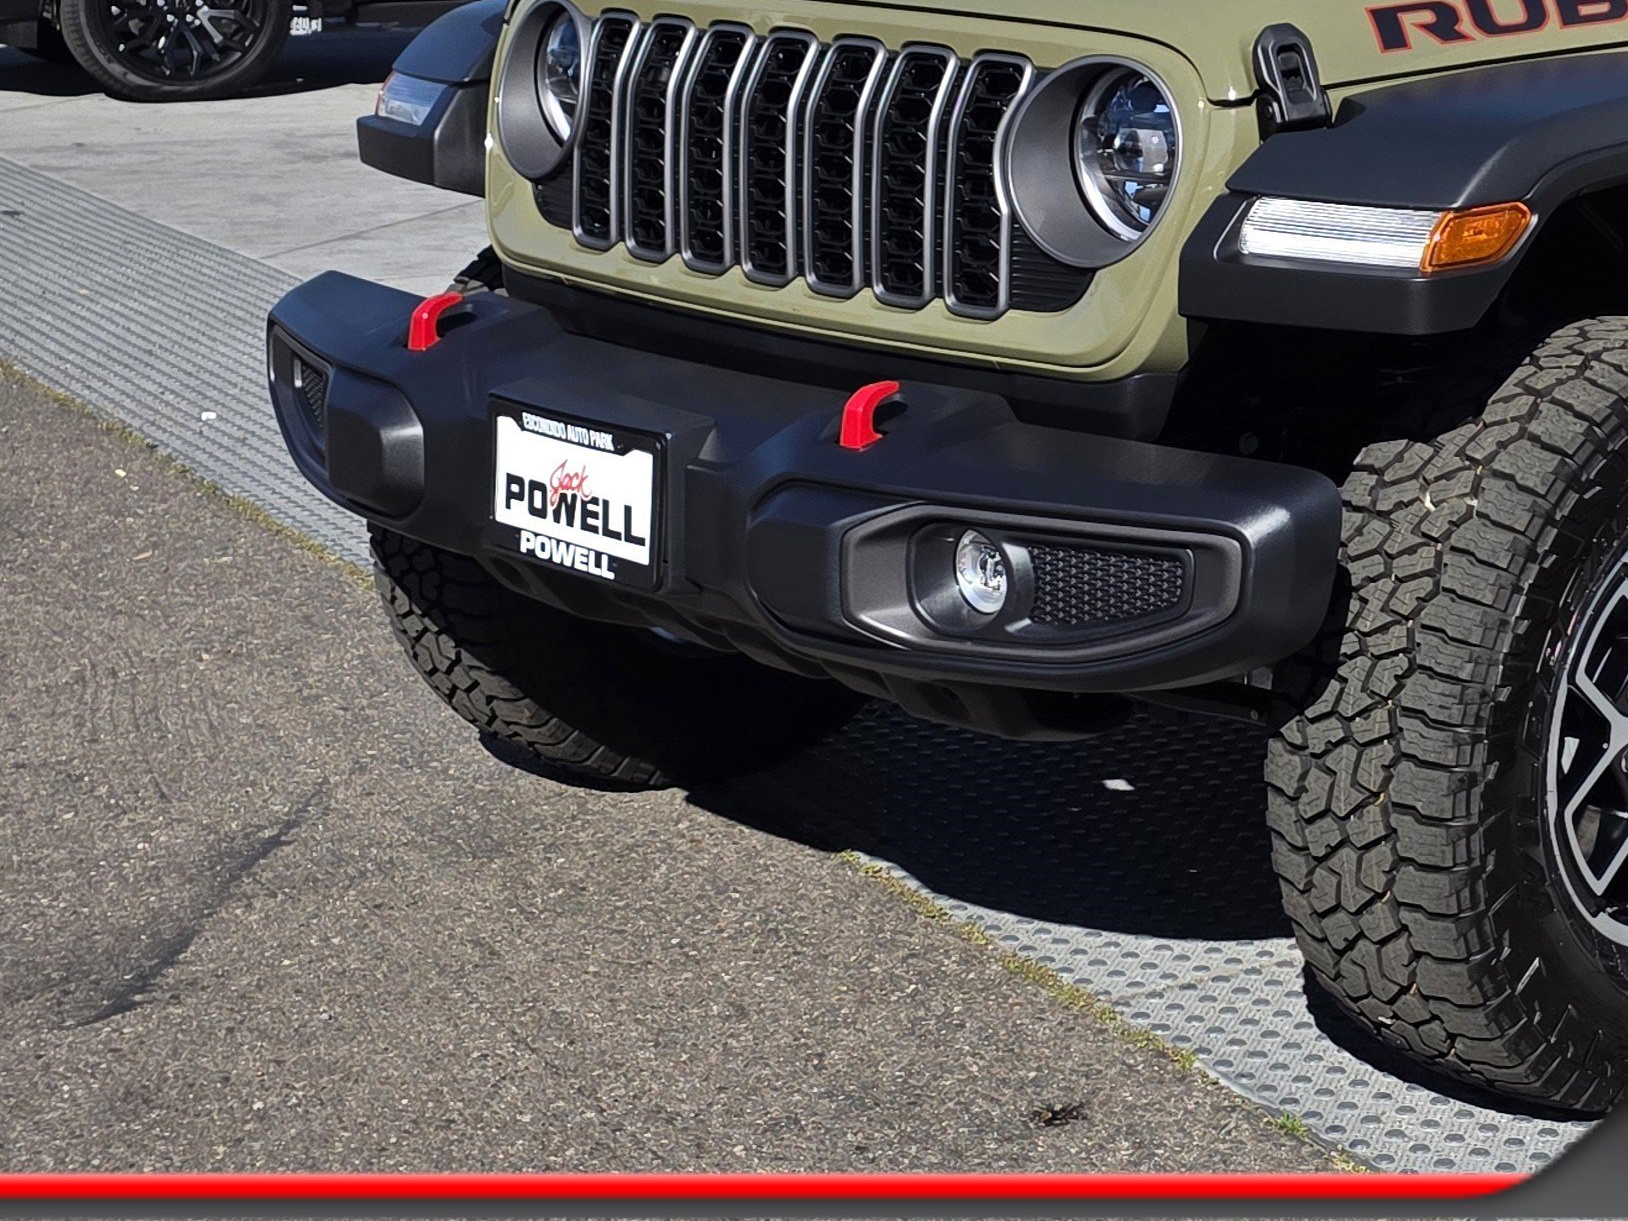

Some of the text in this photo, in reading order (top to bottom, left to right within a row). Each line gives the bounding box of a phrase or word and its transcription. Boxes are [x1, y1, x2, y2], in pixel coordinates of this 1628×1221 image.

[590, 429, 615, 452] PARK
[549, 459, 593, 507] Jack
[505, 472, 646, 547] POWELL
[520, 529, 616, 580] POWELL
